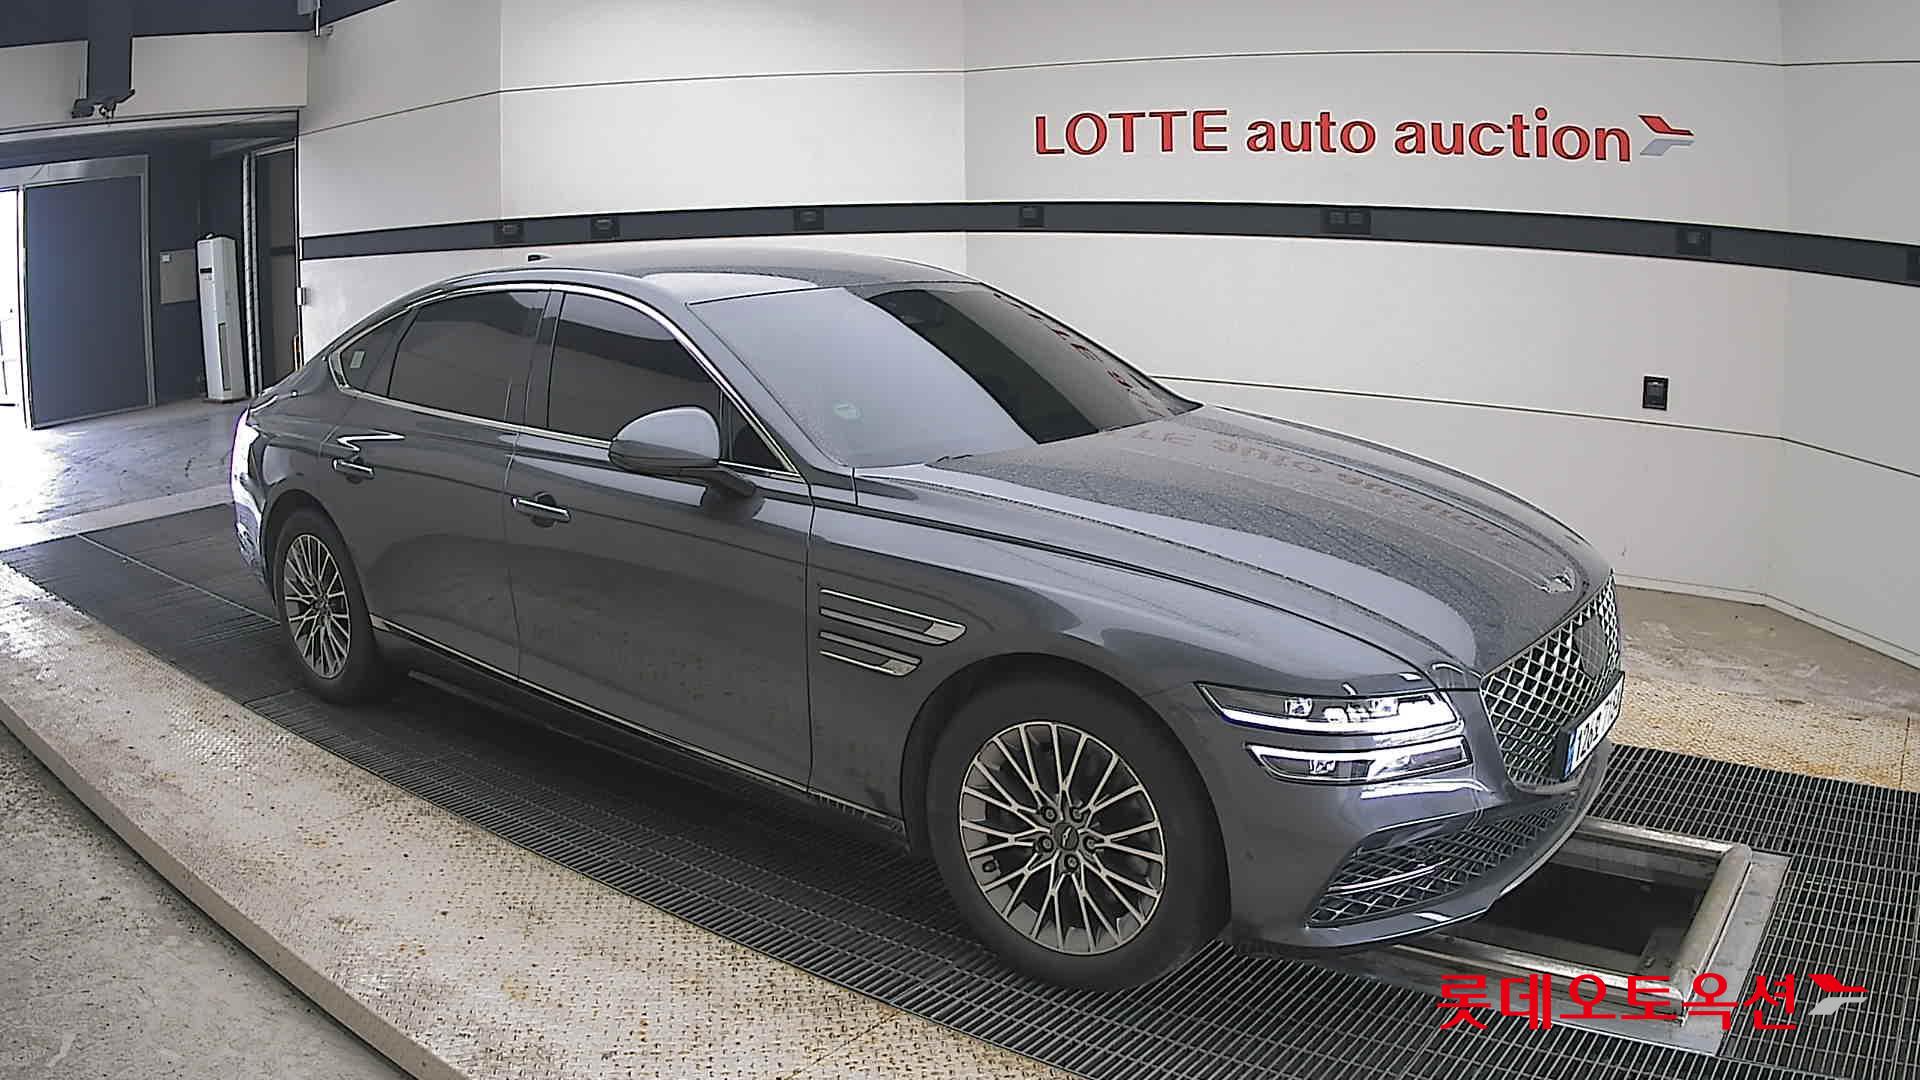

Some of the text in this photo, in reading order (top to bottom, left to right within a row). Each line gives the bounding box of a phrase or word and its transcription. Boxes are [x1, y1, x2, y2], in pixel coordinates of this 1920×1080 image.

[1035, 107, 1632, 162] LOTTE auto auction
